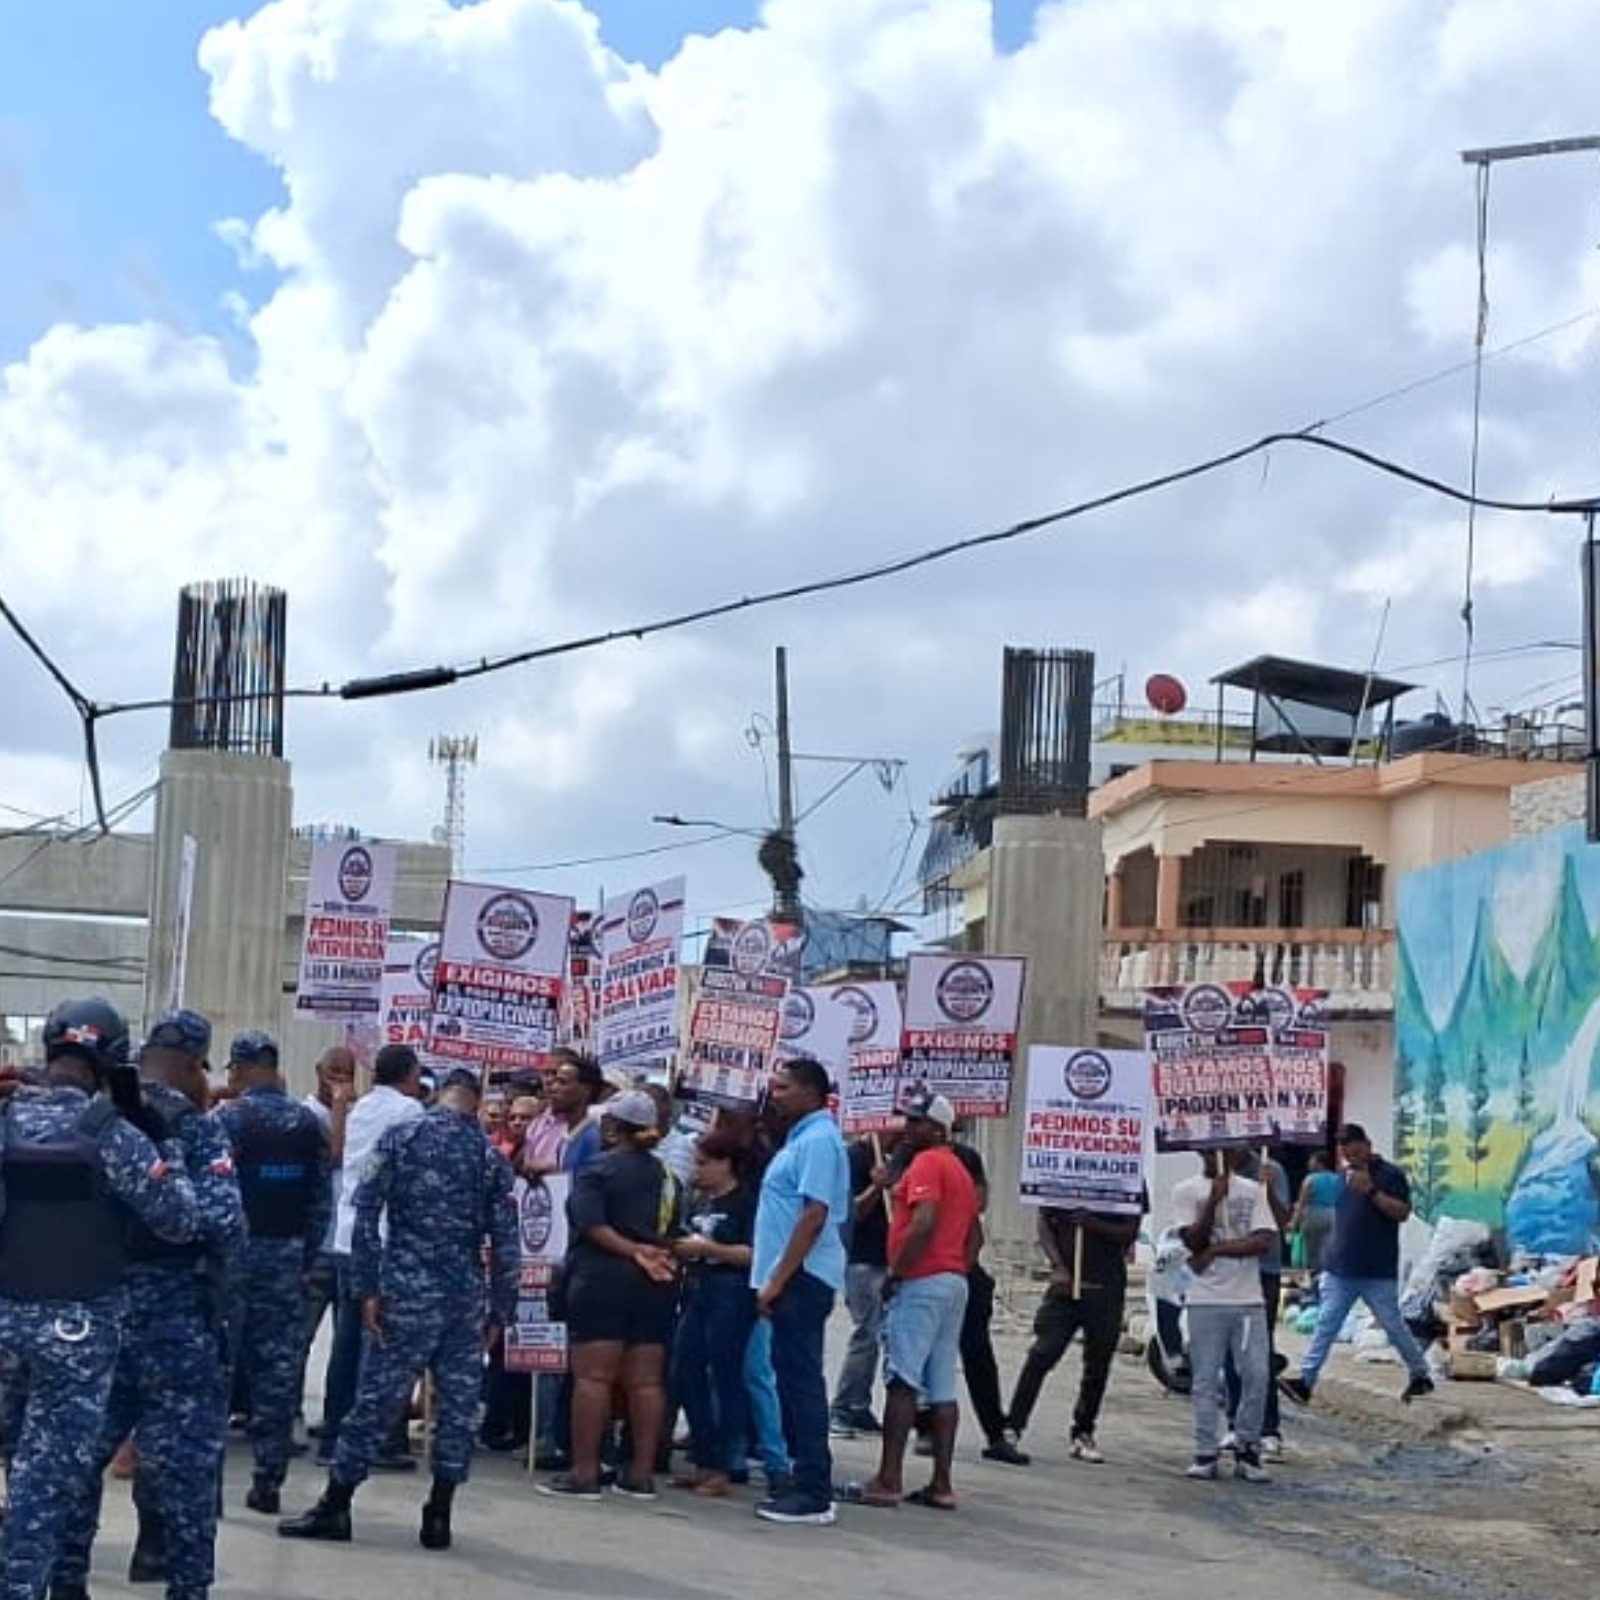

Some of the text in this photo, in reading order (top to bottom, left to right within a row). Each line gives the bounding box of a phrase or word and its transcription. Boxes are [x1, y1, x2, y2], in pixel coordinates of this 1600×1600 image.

[446, 965, 552, 994] EXIGIMOS
[603, 967, 675, 1003] SALVAR
[911, 1031, 1007, 1049] EXIGIMOS
[1159, 1058, 1268, 1078] ESTAMOS
[1030, 1112, 1141, 1138] PEDIMOS SU
[1028, 1153, 1059, 1170] LUIS
